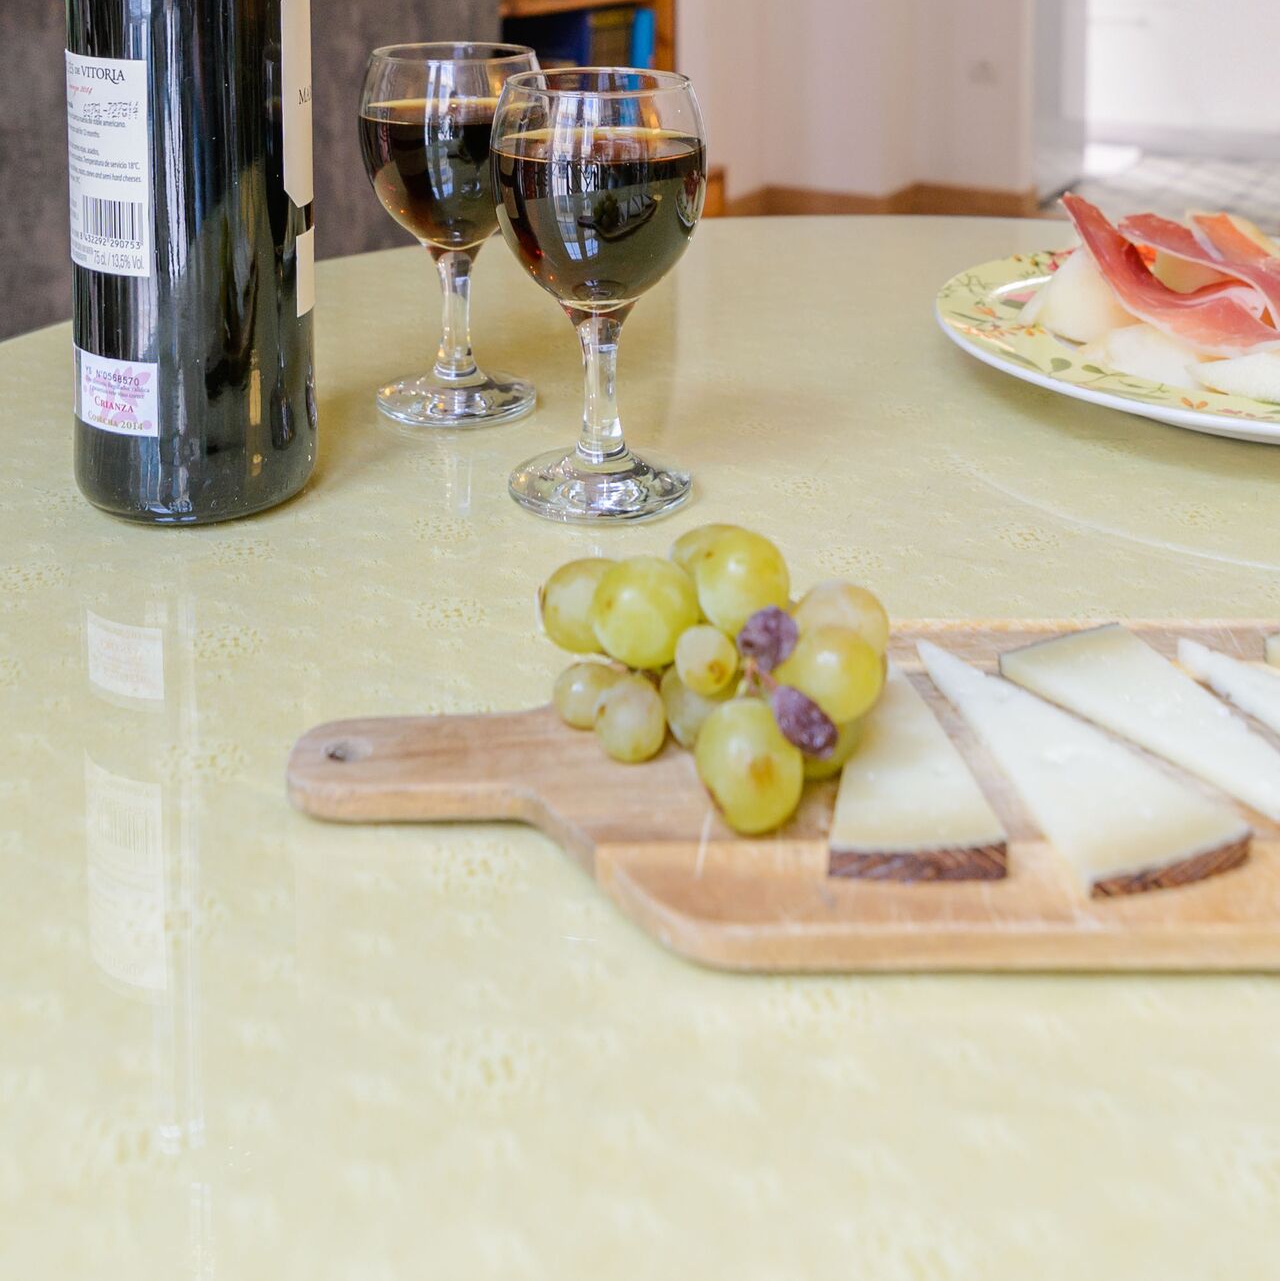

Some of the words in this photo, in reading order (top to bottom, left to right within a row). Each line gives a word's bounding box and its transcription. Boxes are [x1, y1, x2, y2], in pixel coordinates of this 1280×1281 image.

[81, 65, 126, 85] VITORIA
[110, 161, 127, 169] servicio
[112, 173, 123, 182] hard
[85, 233, 107, 247] 432292
[110, 238, 141, 250] 290753
[112, 254, 131, 270] 13,5%
[132, 255, 145, 270] Vol.
[120, 421, 144, 430] 2014
